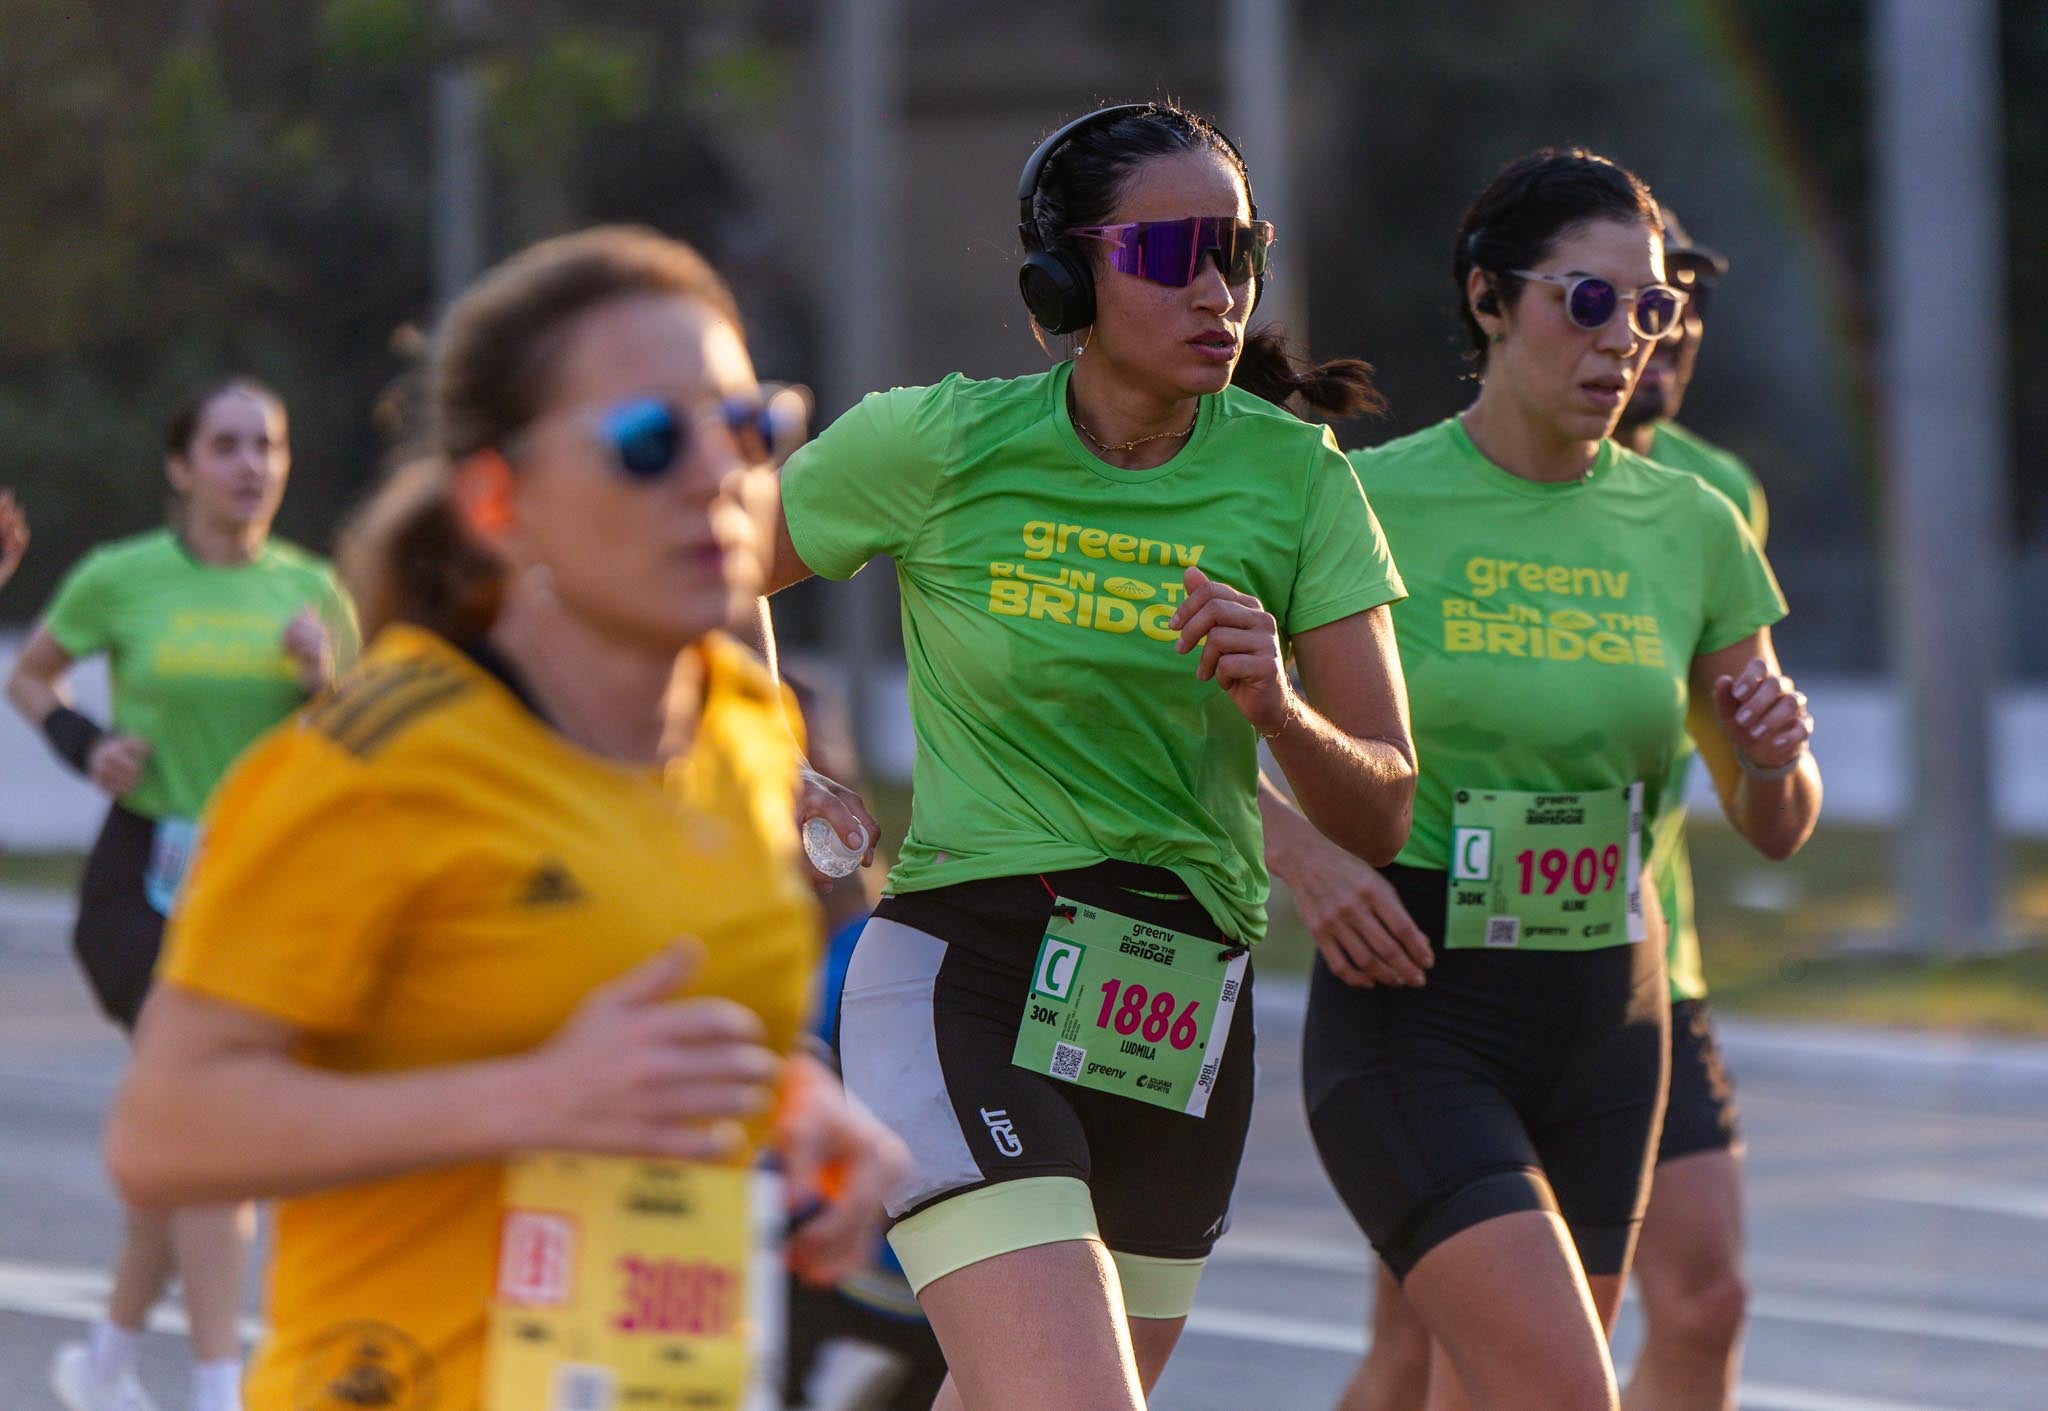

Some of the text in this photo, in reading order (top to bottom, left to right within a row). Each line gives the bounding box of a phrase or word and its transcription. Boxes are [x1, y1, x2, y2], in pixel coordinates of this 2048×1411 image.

[1022, 520, 1205, 567] greenv
[990, 562, 1095, 592] RUN
[1465, 557, 1629, 599] greenv
[989, 579, 1207, 646] BRIDG
[1600, 613, 1659, 635] THE
[1444, 620, 1666, 668] BRIDGE
[1464, 835, 1481, 874] C
[1516, 843, 1621, 895] 1909
[1132, 924, 1174, 942] greenv
[1119, 942, 1174, 966] BRIDGE
[1161, 946, 1176, 955] THE
[1045, 949, 1070, 991] C
[1221, 979, 1236, 1001] 1886
[1030, 1005, 1059, 1027] 30K
[1096, 979, 1201, 1050] 1886
[1120, 1040, 1156, 1060] LUDMILA
[1087, 1062, 1126, 1080] greenv
[1198, 1064, 1213, 1086] 1886
[980, 1107, 1023, 1157] GRIT
